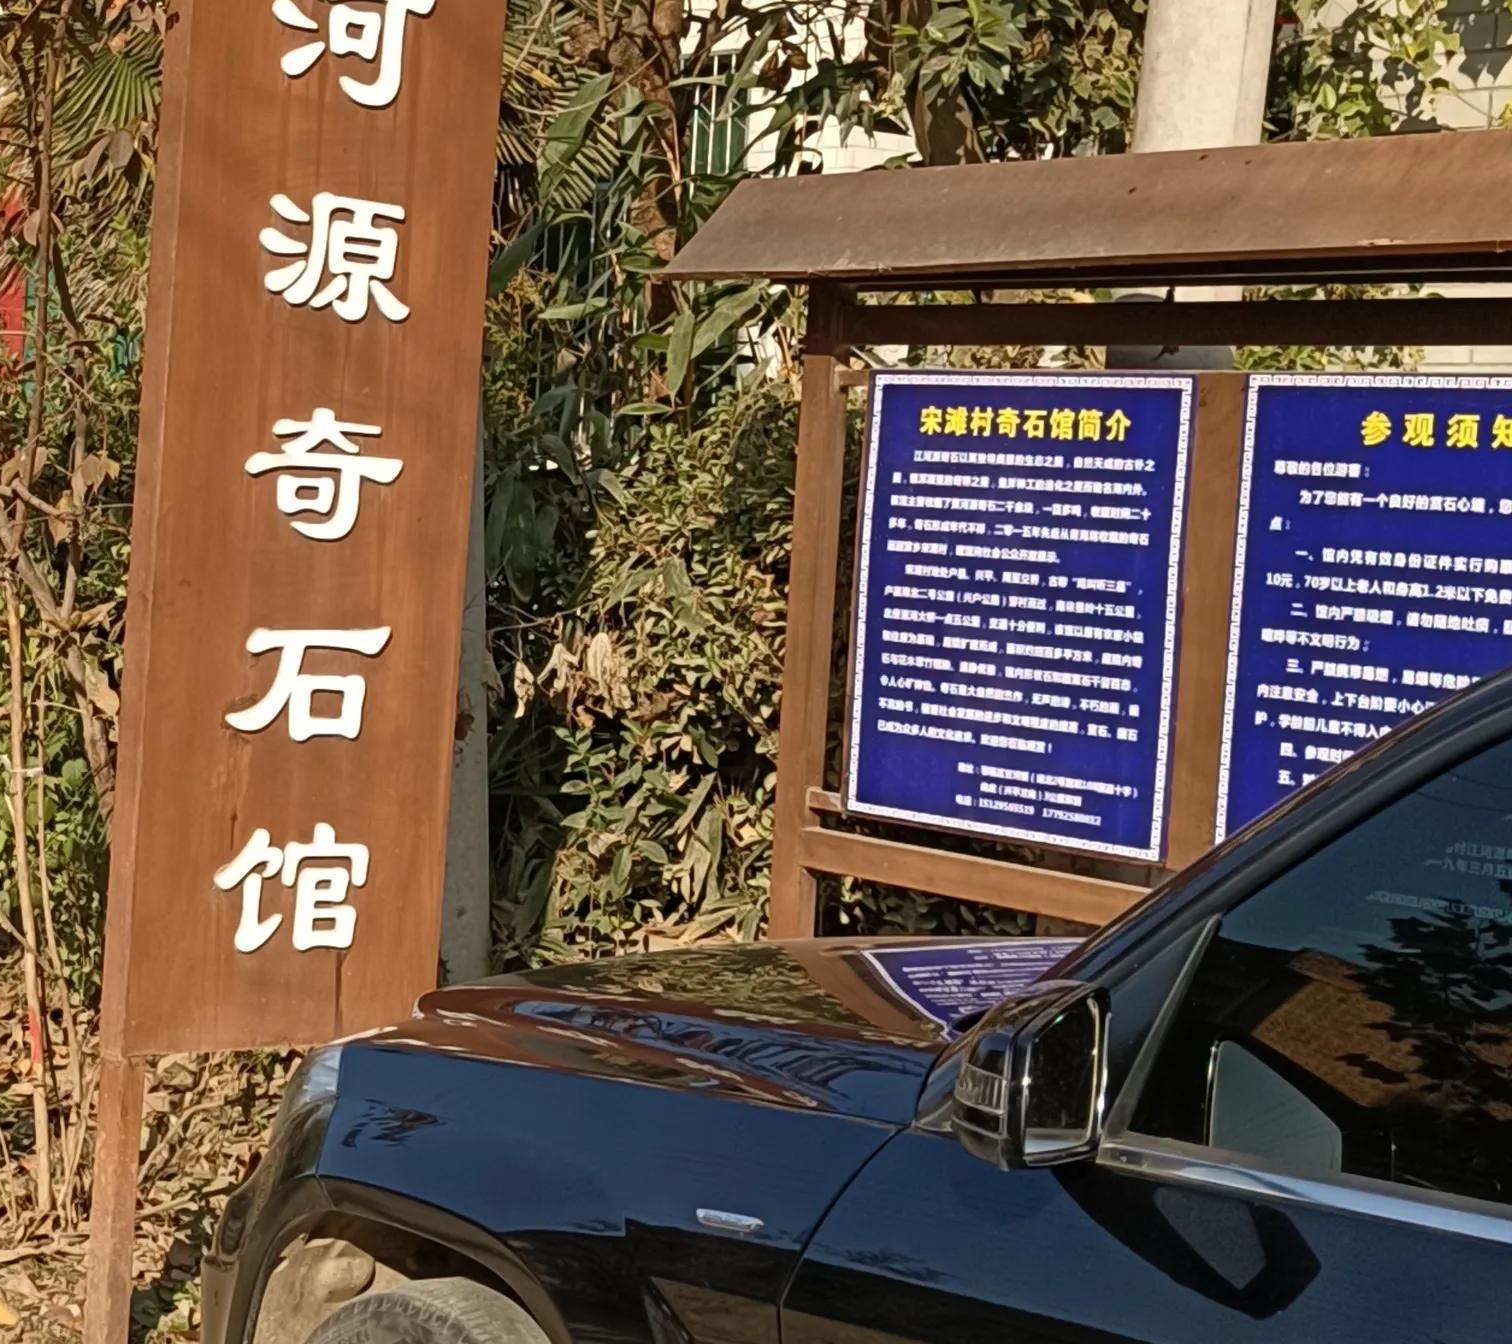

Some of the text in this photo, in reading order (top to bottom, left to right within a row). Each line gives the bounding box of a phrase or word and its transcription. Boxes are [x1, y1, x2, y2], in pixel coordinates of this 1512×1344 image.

[919, 405, 1131, 441] 宋滩村奇石馆简介
[1360, 410, 1512, 448] 参观须知
[1257, 684, 1437, 715] 内注意安全，上下台阶要小心
